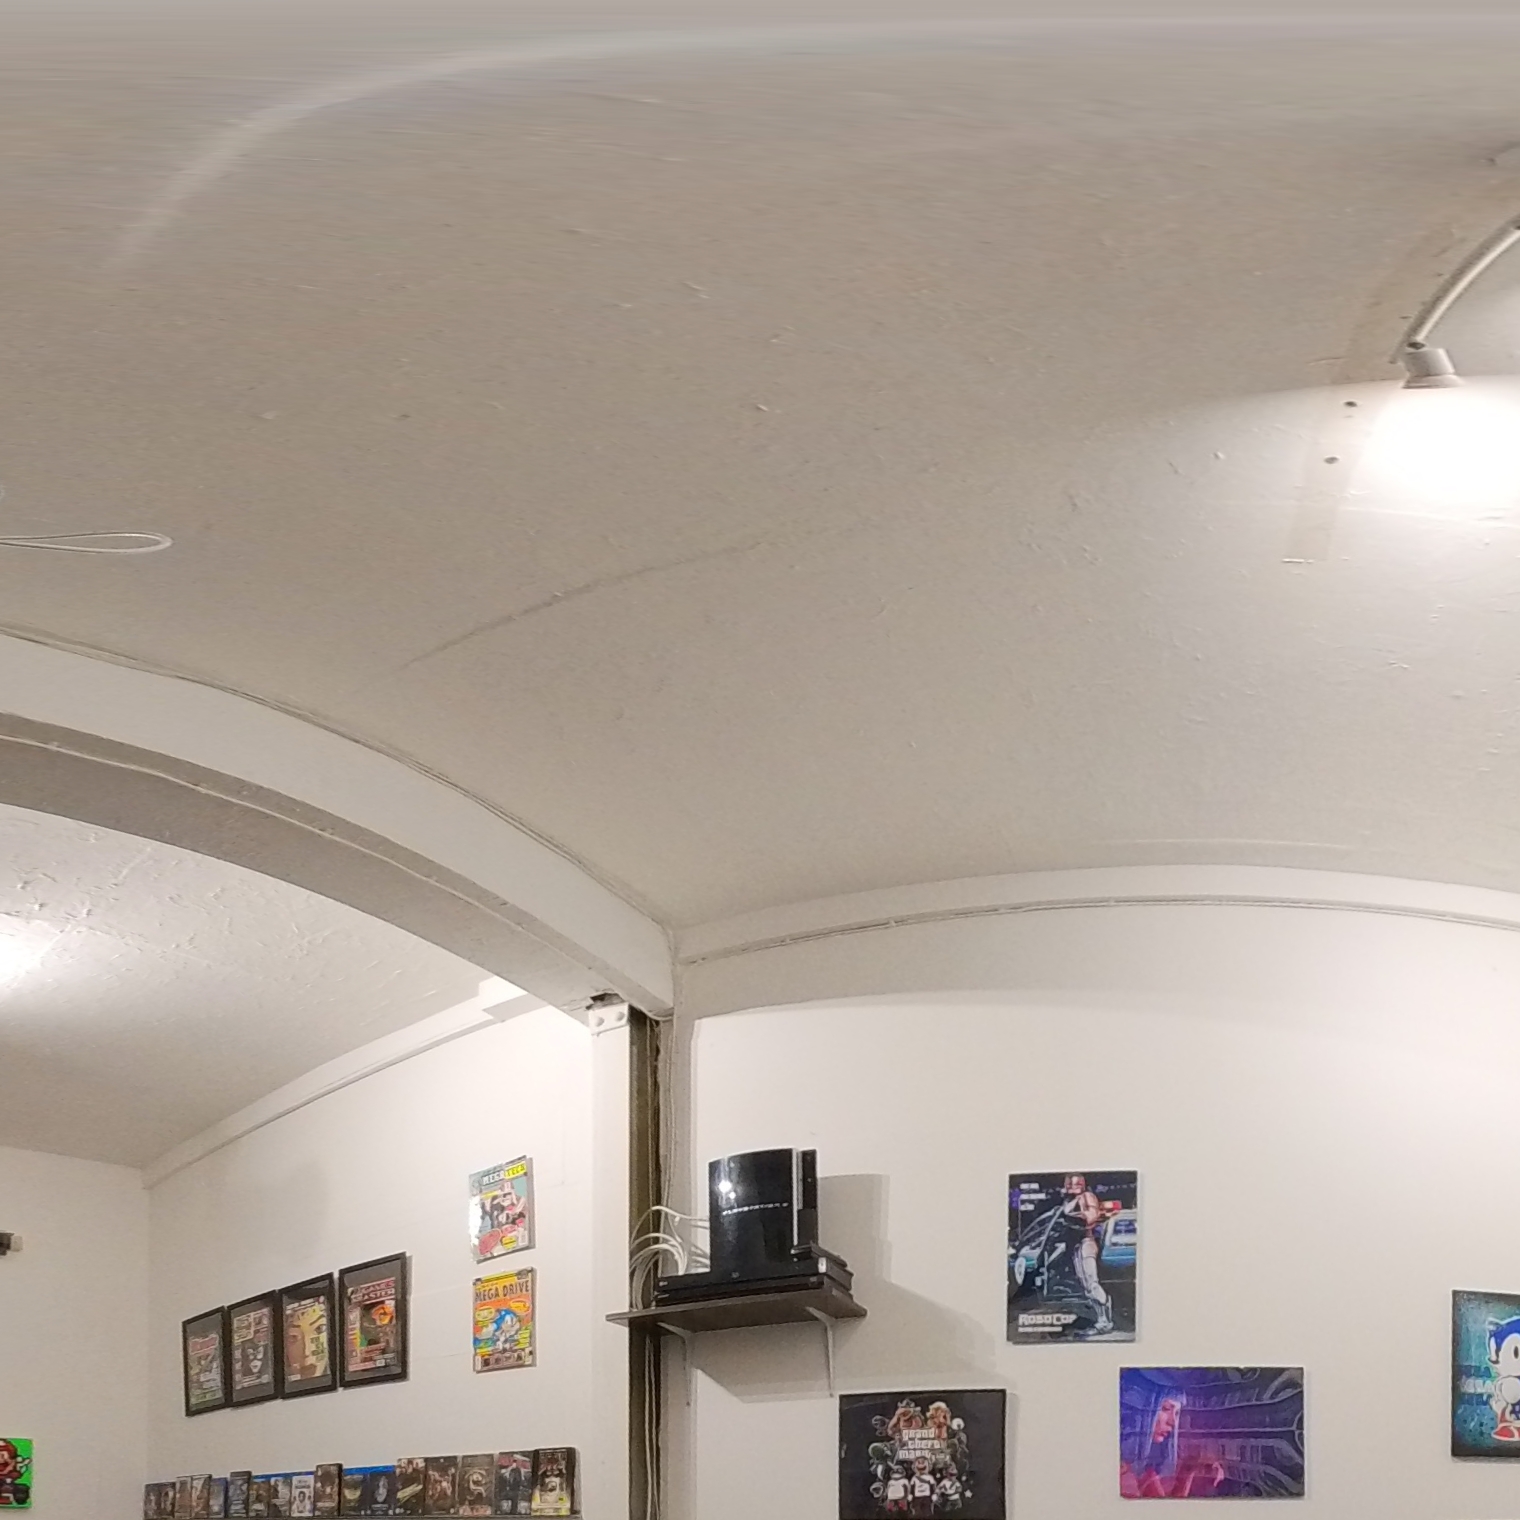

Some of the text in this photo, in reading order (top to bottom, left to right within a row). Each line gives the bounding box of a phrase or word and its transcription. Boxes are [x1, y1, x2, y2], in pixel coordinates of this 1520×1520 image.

[476, 1280, 530, 1301] MEGA DRIVE
[902, 1428, 935, 1440] grand
